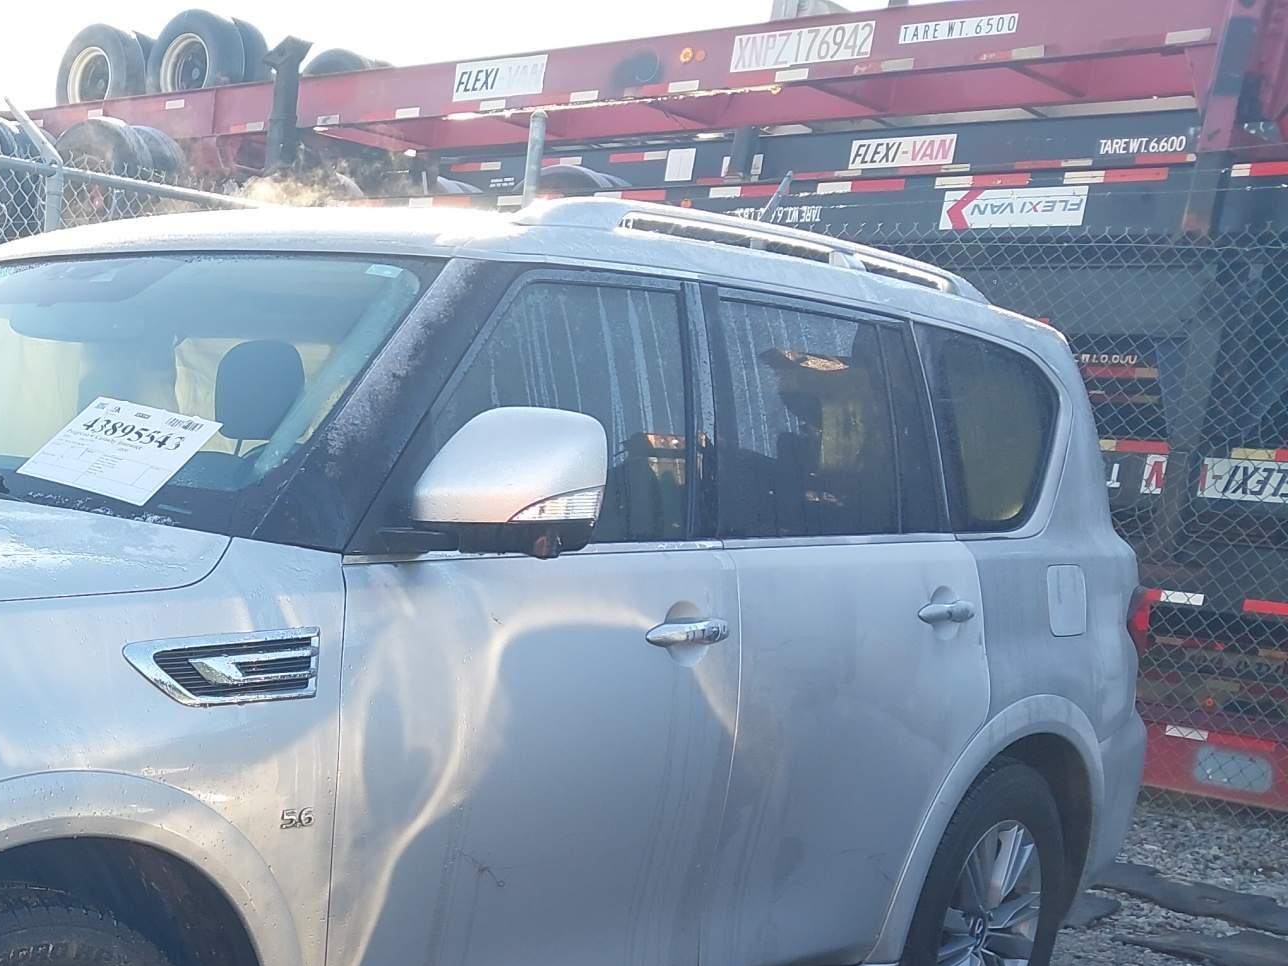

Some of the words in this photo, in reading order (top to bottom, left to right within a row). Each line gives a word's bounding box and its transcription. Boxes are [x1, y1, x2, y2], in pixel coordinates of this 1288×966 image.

[903, 23, 941, 42] TARE
[947, 21, 969, 38] WT.
[975, 15, 1016, 35] 6500
[851, 138, 955, 165] FLEXI-VAN
[1099, 138, 1129, 155] TARE
[970, 201, 1014, 216] VAN
[1020, 198, 1084, 214] FLEXI
[82, 416, 186, 451] 43895543
